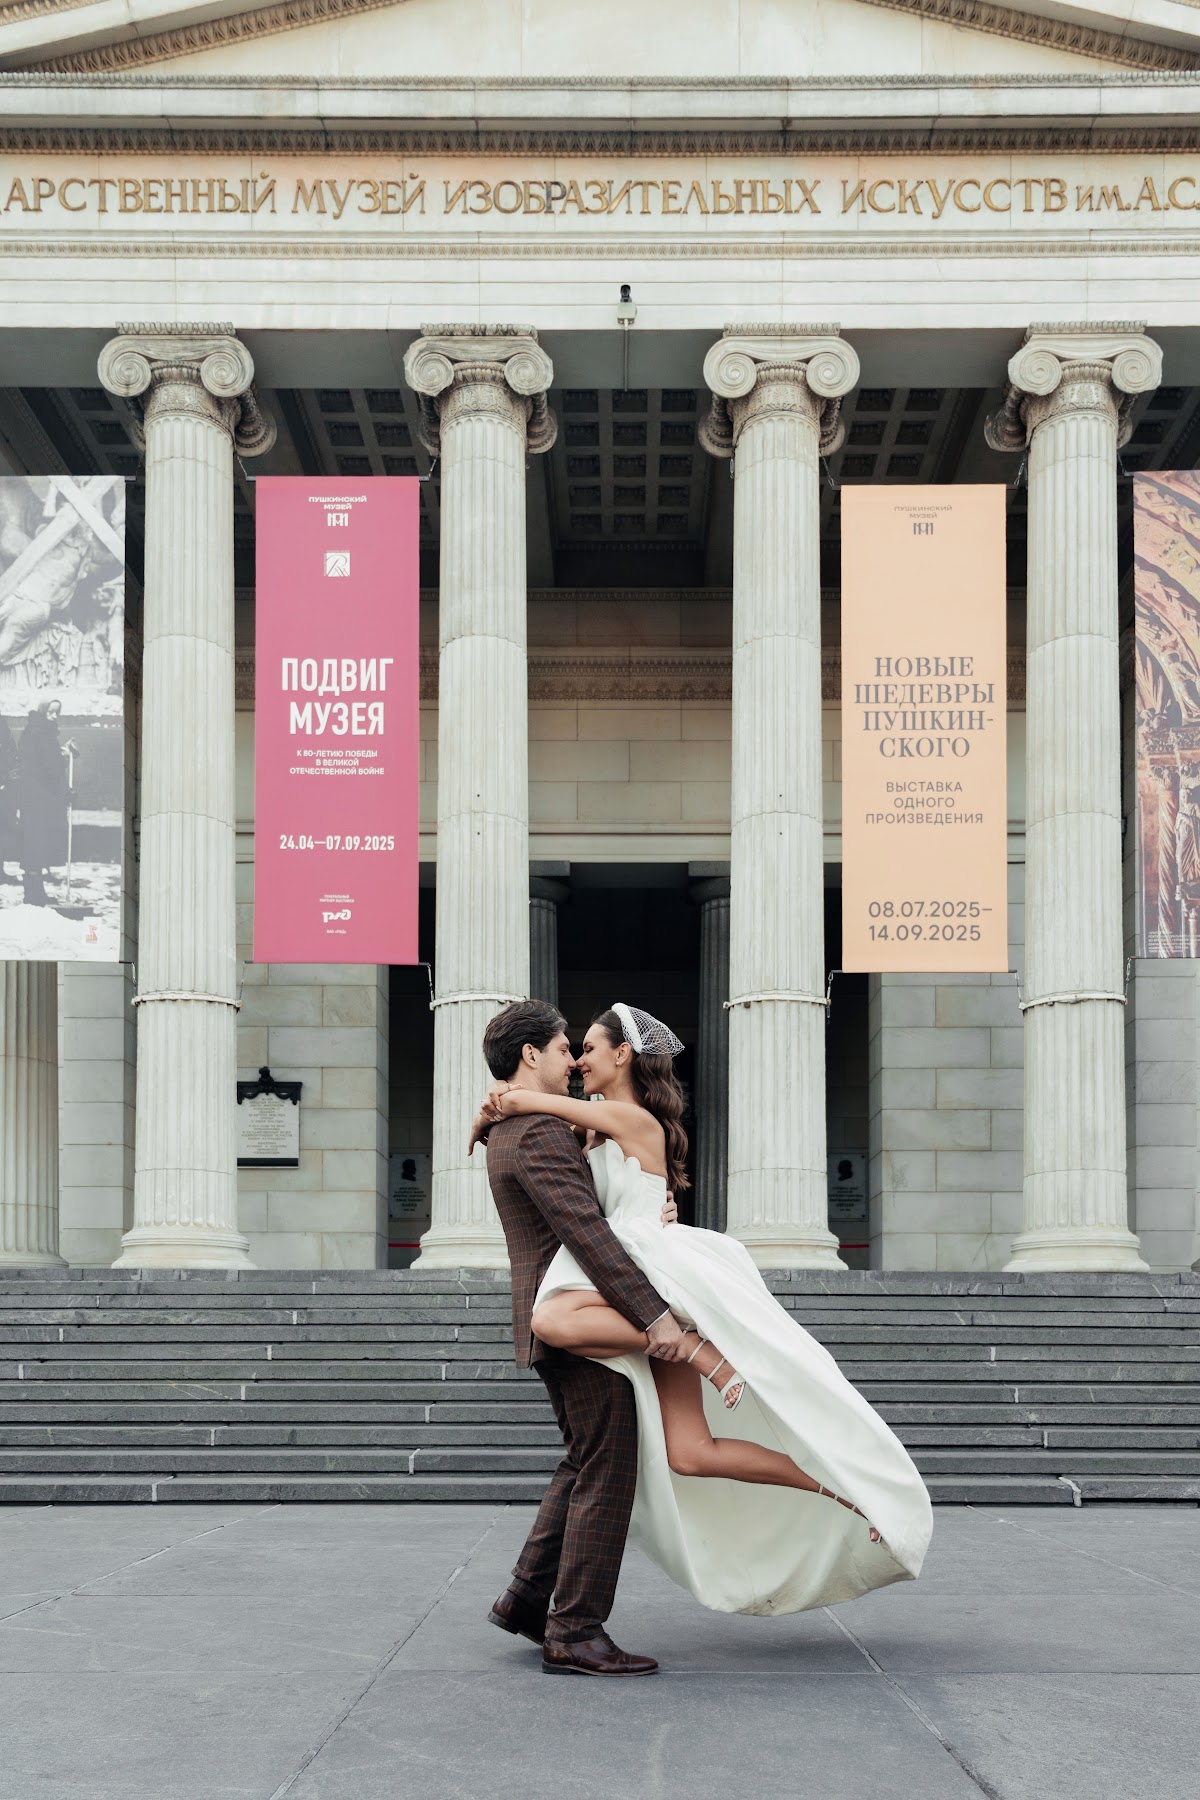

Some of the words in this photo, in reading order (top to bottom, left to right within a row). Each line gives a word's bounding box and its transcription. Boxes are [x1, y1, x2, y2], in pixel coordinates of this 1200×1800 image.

[0, 171, 277, 214] АРСТВЕННЫЙ
[291, 171, 426, 220] МУЗЕЙ
[443, 179, 821, 214] ИЗОБРАЗИТЕЛЬНЫХ
[841, 177, 1069, 219] ИСКУССТВ
[308, 495, 367, 503] ПУШКИНСКИЙ
[323, 503, 352, 511] МУЗЕЙ
[875, 657, 974, 678] НОВЫЕ
[281, 658, 394, 696] ПОДВИГ
[854, 684, 995, 710] ШЕДЕВРЫ
[289, 702, 385, 736] МУЗЕЯ
[863, 710, 994, 732] ПУШКИН-
[345, 750, 377, 758] ПОБЕДЫ
[879, 737, 971, 758] СКОГО
[323, 758, 359, 766] ВЕЛИКОЙ
[289, 766, 357, 775] ОТЕЧЕСТВЕННОЙ
[358, 766, 384, 775] ВОЙНЕ
[886, 781, 963, 793] ВЫСТАВКА
[893, 797, 955, 811] ОДНОГО
[865, 813, 983, 826] ПРОИЗВЕДЕНИЯ
[868, 925, 981, 941] 14.09.2025
